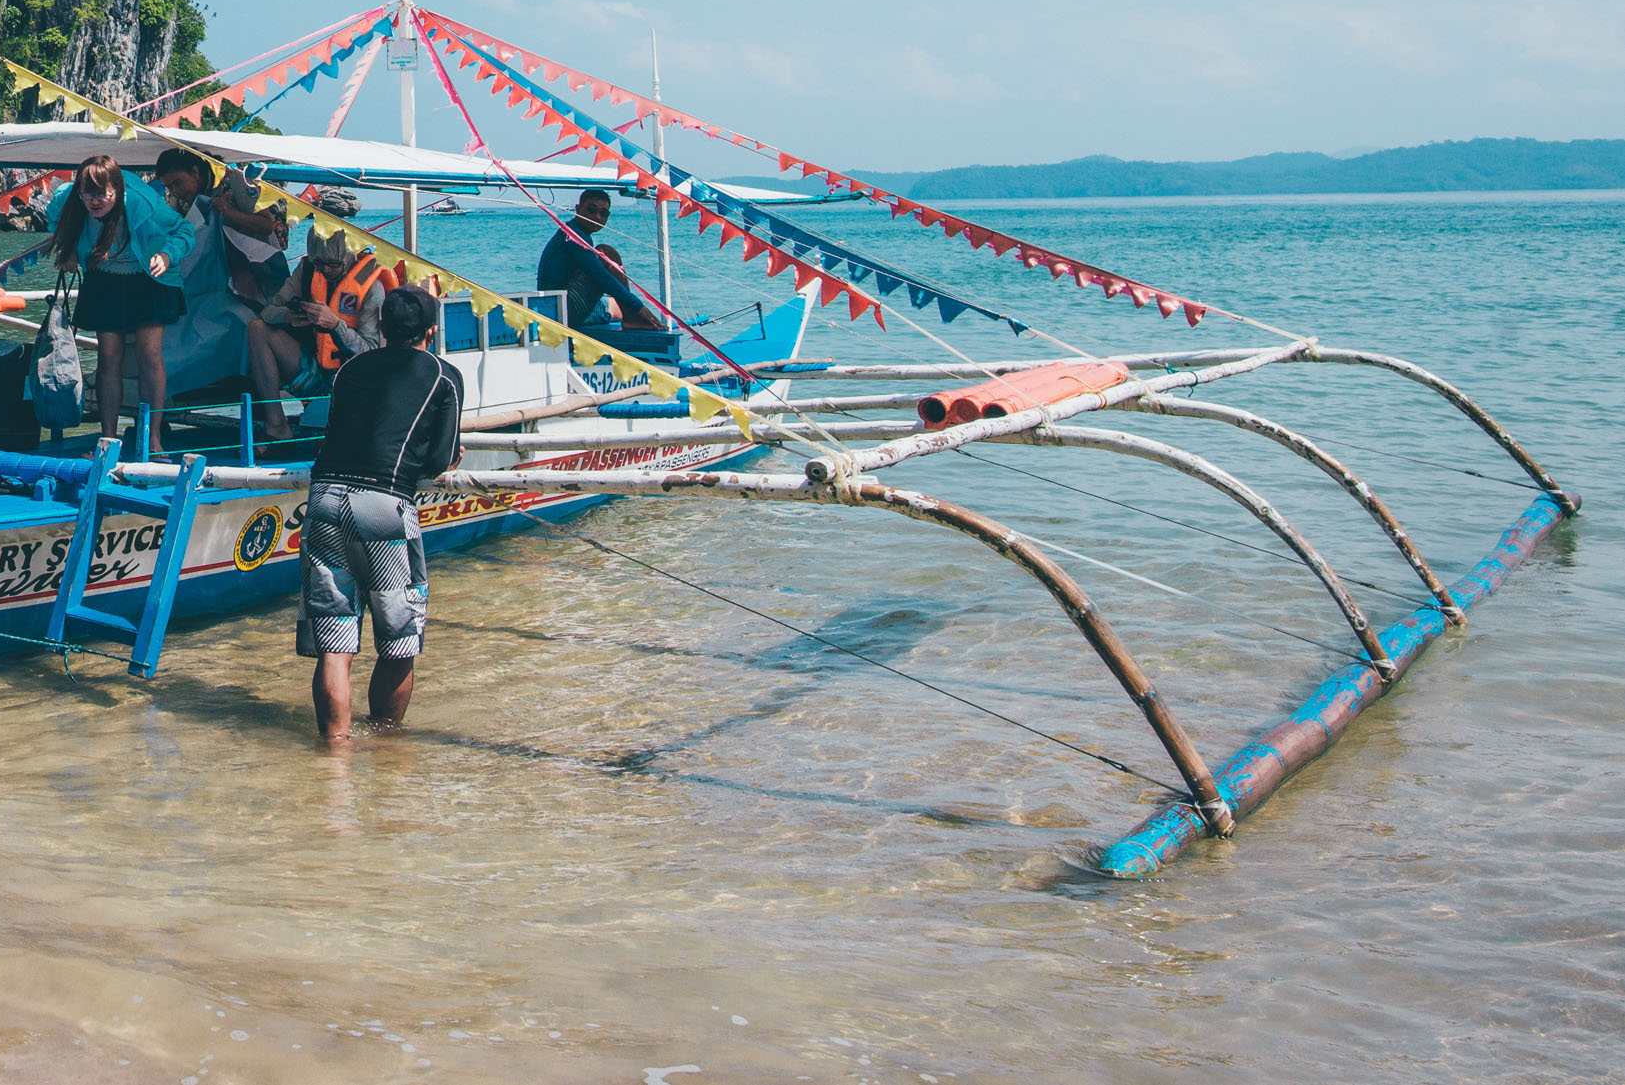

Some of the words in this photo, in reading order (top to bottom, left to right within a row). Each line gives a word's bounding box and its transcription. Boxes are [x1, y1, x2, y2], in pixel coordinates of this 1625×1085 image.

[580, 446, 659, 470] PASSENGER
[660, 446, 711, 470] PASSENGERS
[46, 524, 167, 566] SRVICE
